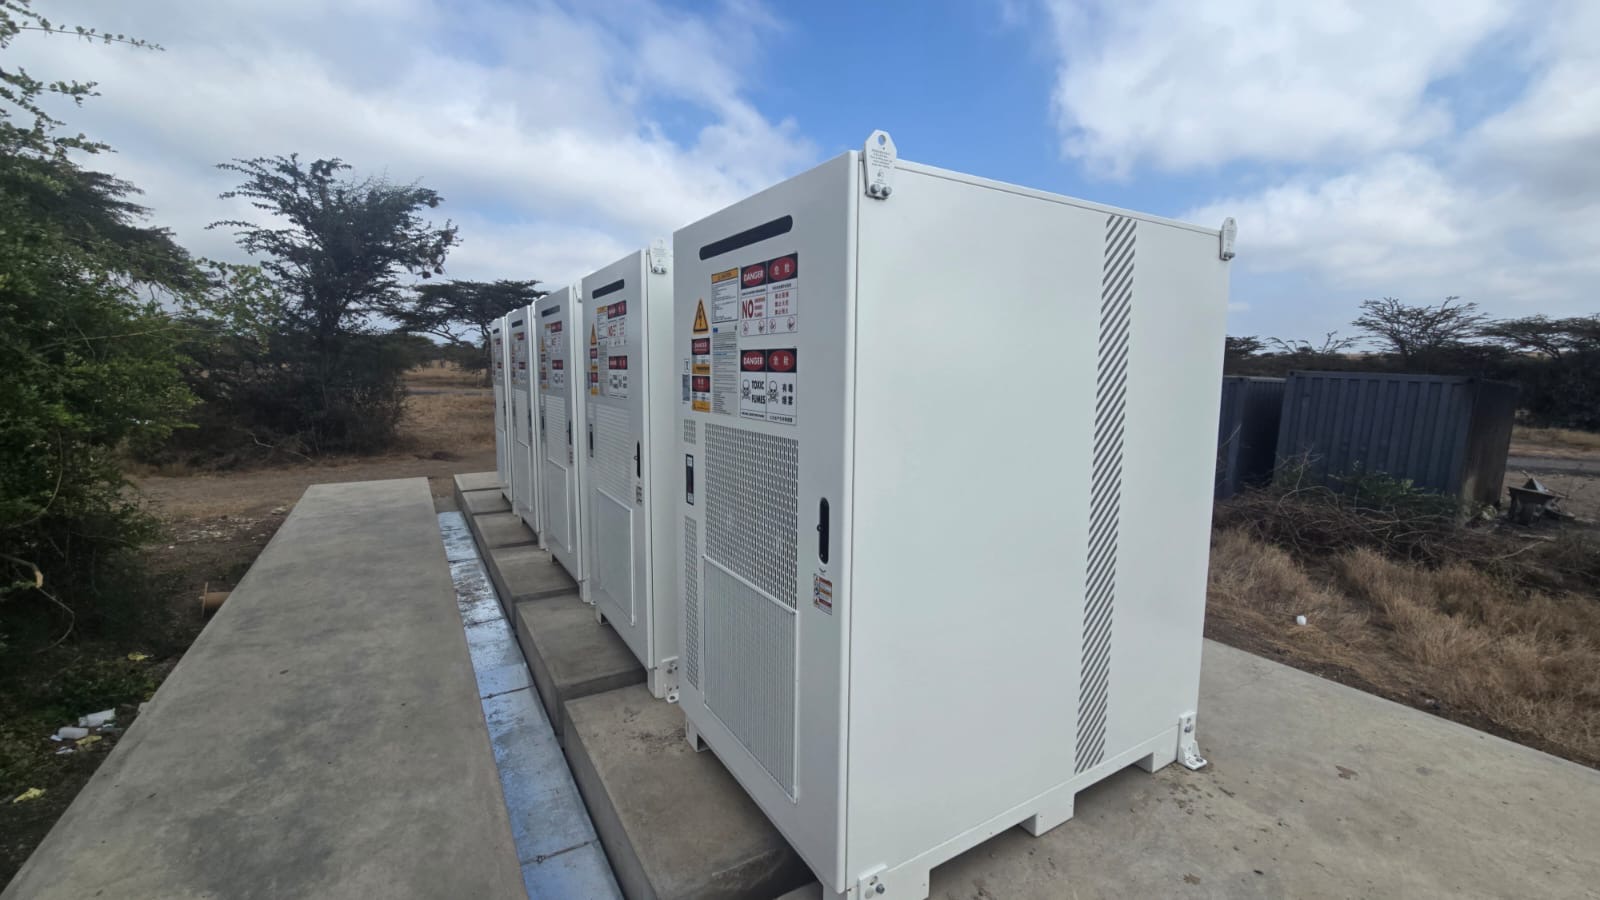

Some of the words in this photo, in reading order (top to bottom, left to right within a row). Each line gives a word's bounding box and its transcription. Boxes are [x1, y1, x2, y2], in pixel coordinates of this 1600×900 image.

[743, 269, 764, 282] DANGER
[742, 299, 754, 319] NO
[743, 356, 764, 366] DANGER
[751, 380, 765, 390] TOXIC
[751, 394, 766, 404] FUMES
